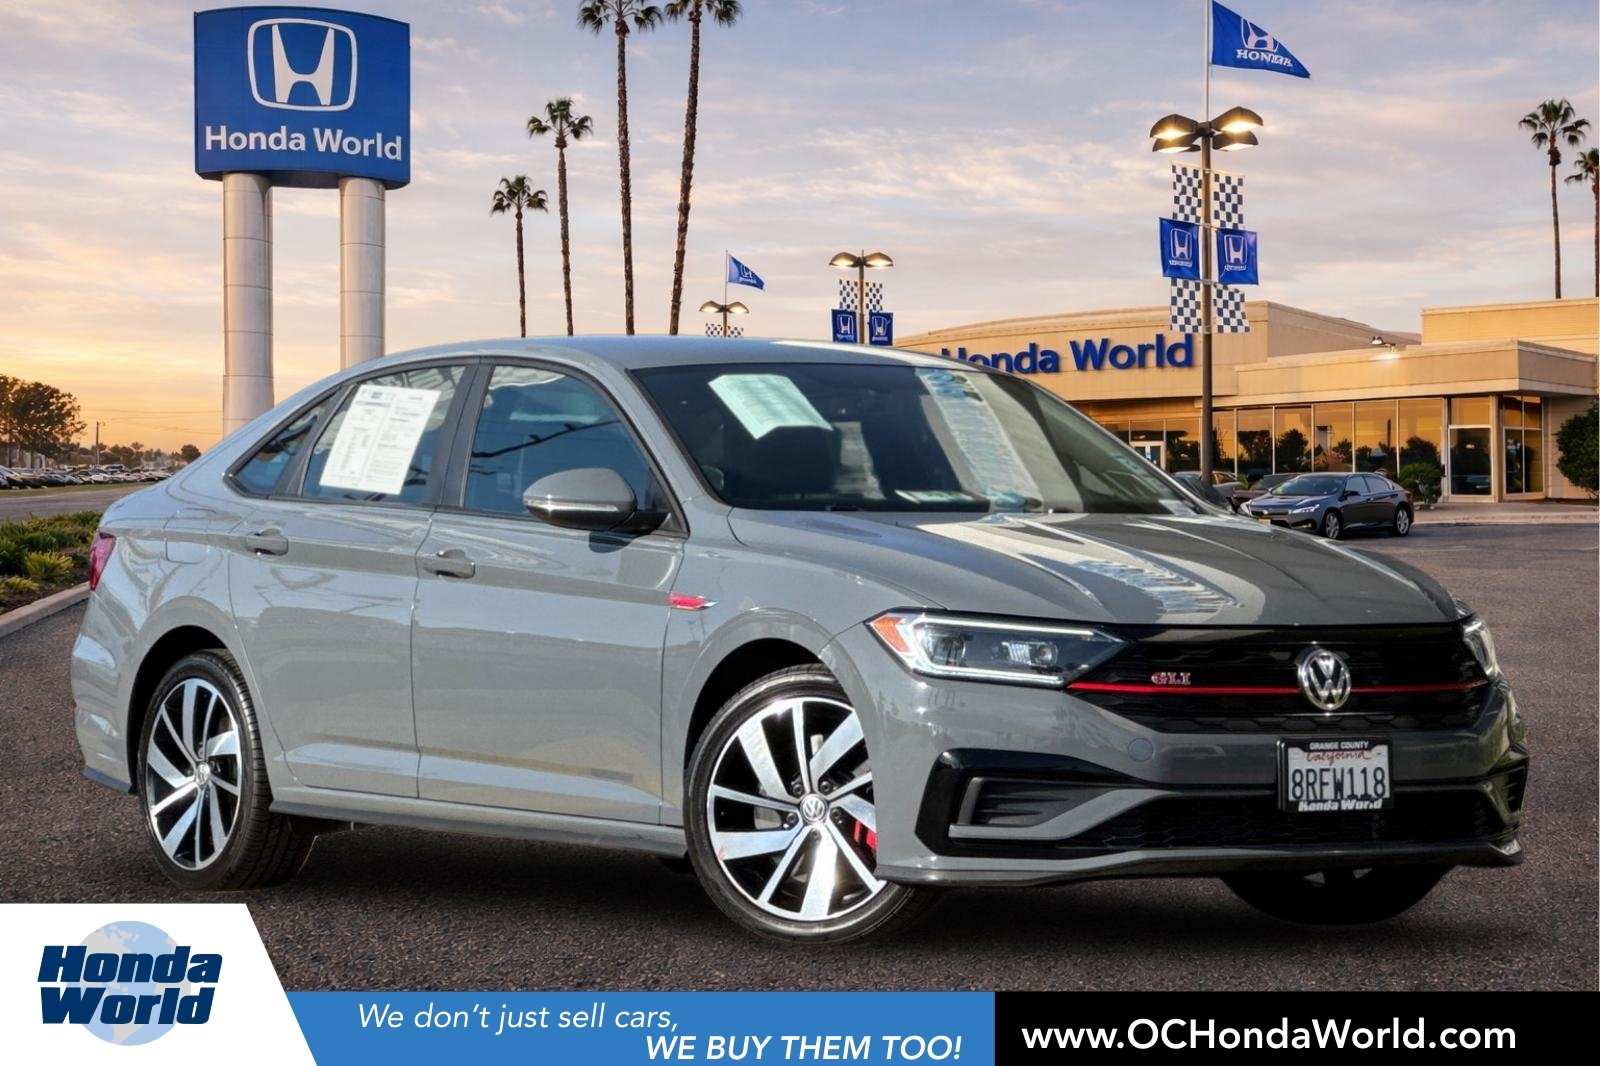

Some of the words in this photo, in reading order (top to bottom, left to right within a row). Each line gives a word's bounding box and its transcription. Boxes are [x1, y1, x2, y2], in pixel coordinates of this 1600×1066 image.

[205, 125, 306, 151] Honda
[313, 127, 402, 160] World
[1070, 333, 1194, 372] World
[1151, 671, 1192, 685] GLI
[1309, 742, 1339, 750] ORANGE
[1341, 741, 1369, 750] COUNTY
[1306, 750, 1373, 766] California
[1291, 767, 1386, 801] 8RFW118
[1298, 800, 1339, 812] Honda
